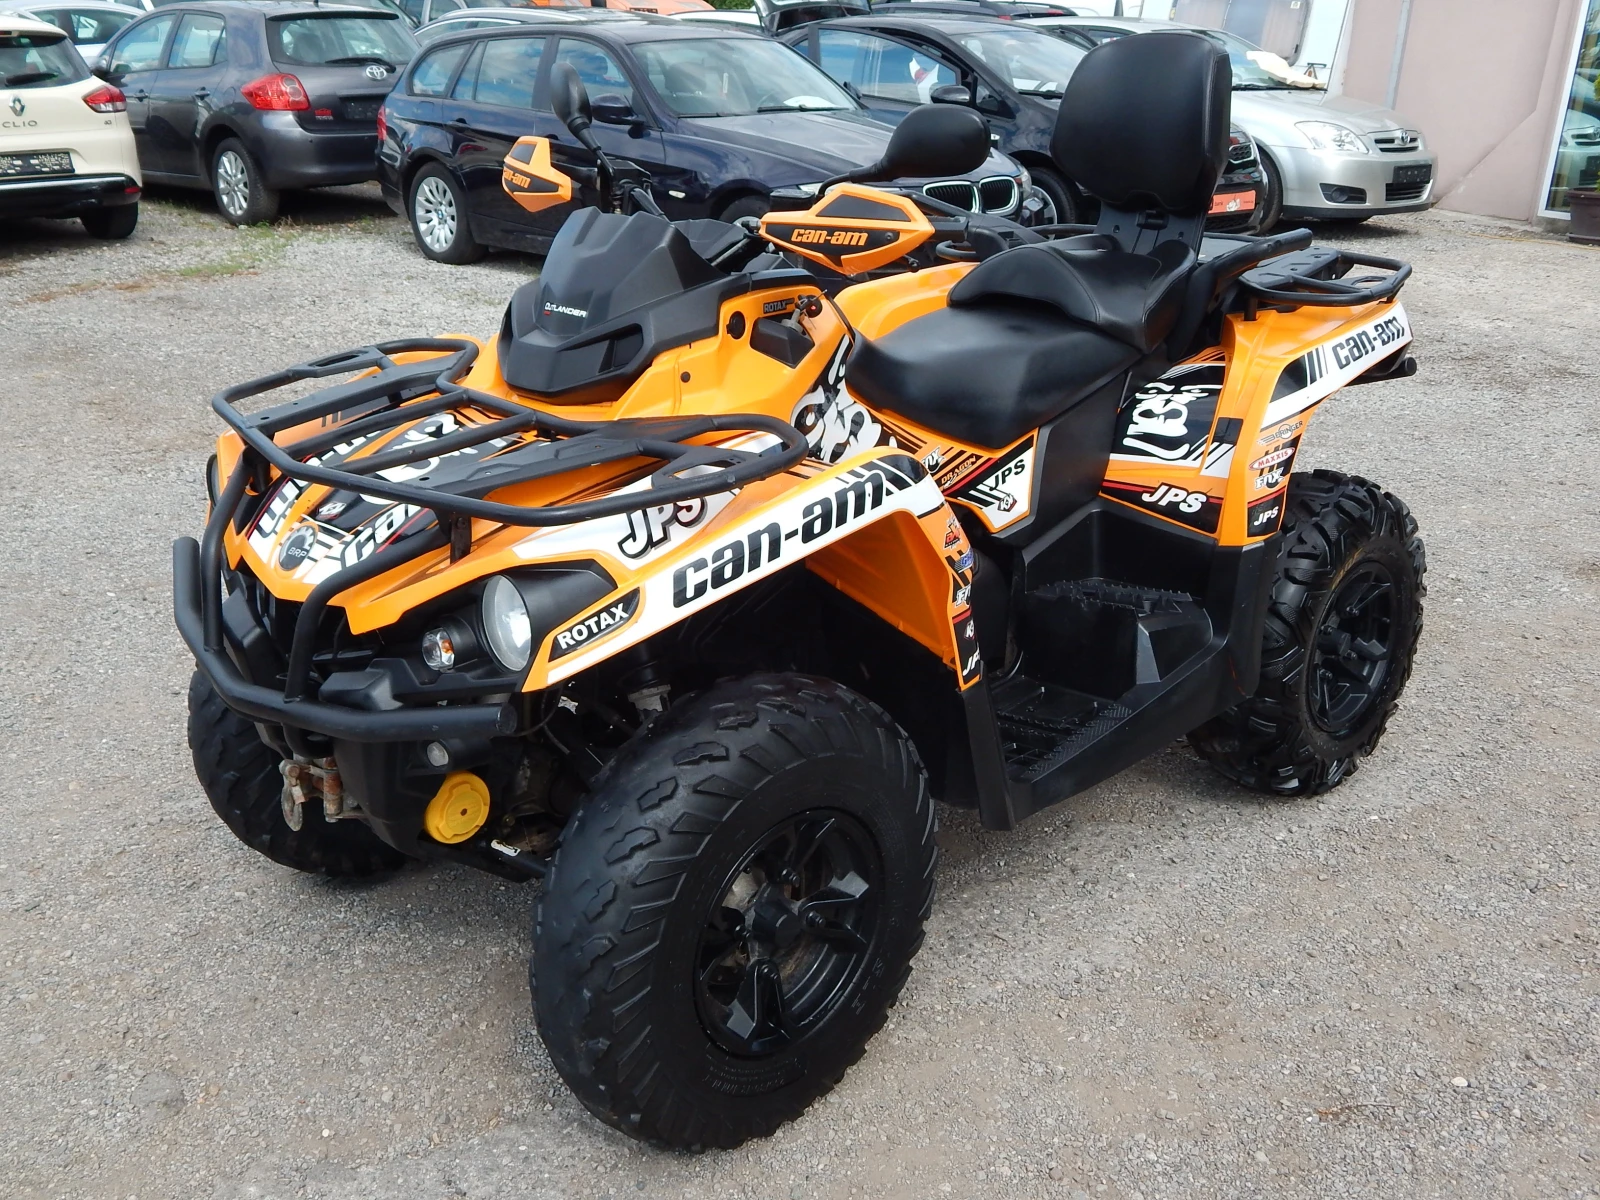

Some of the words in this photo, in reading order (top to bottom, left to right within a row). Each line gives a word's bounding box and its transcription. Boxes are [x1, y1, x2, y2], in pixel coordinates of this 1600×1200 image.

[2, 120, 37, 128] CLIO
[791, 229, 869, 246] can-am
[544, 302, 587, 318] OUTLANDER
[764, 301, 787, 313] ROTAX
[1331, 316, 1405, 370] can-am
[1257, 451, 1289, 467] MAXXIS
[941, 456, 977, 484] DRAGON
[989, 459, 1025, 491] JPS
[1142, 484, 1207, 513] JPS
[1254, 506, 1279, 526] JPS
[673, 472, 884, 608] can-am
[287, 546, 307, 558] BRP
[557, 603, 629, 649] ROTAX
